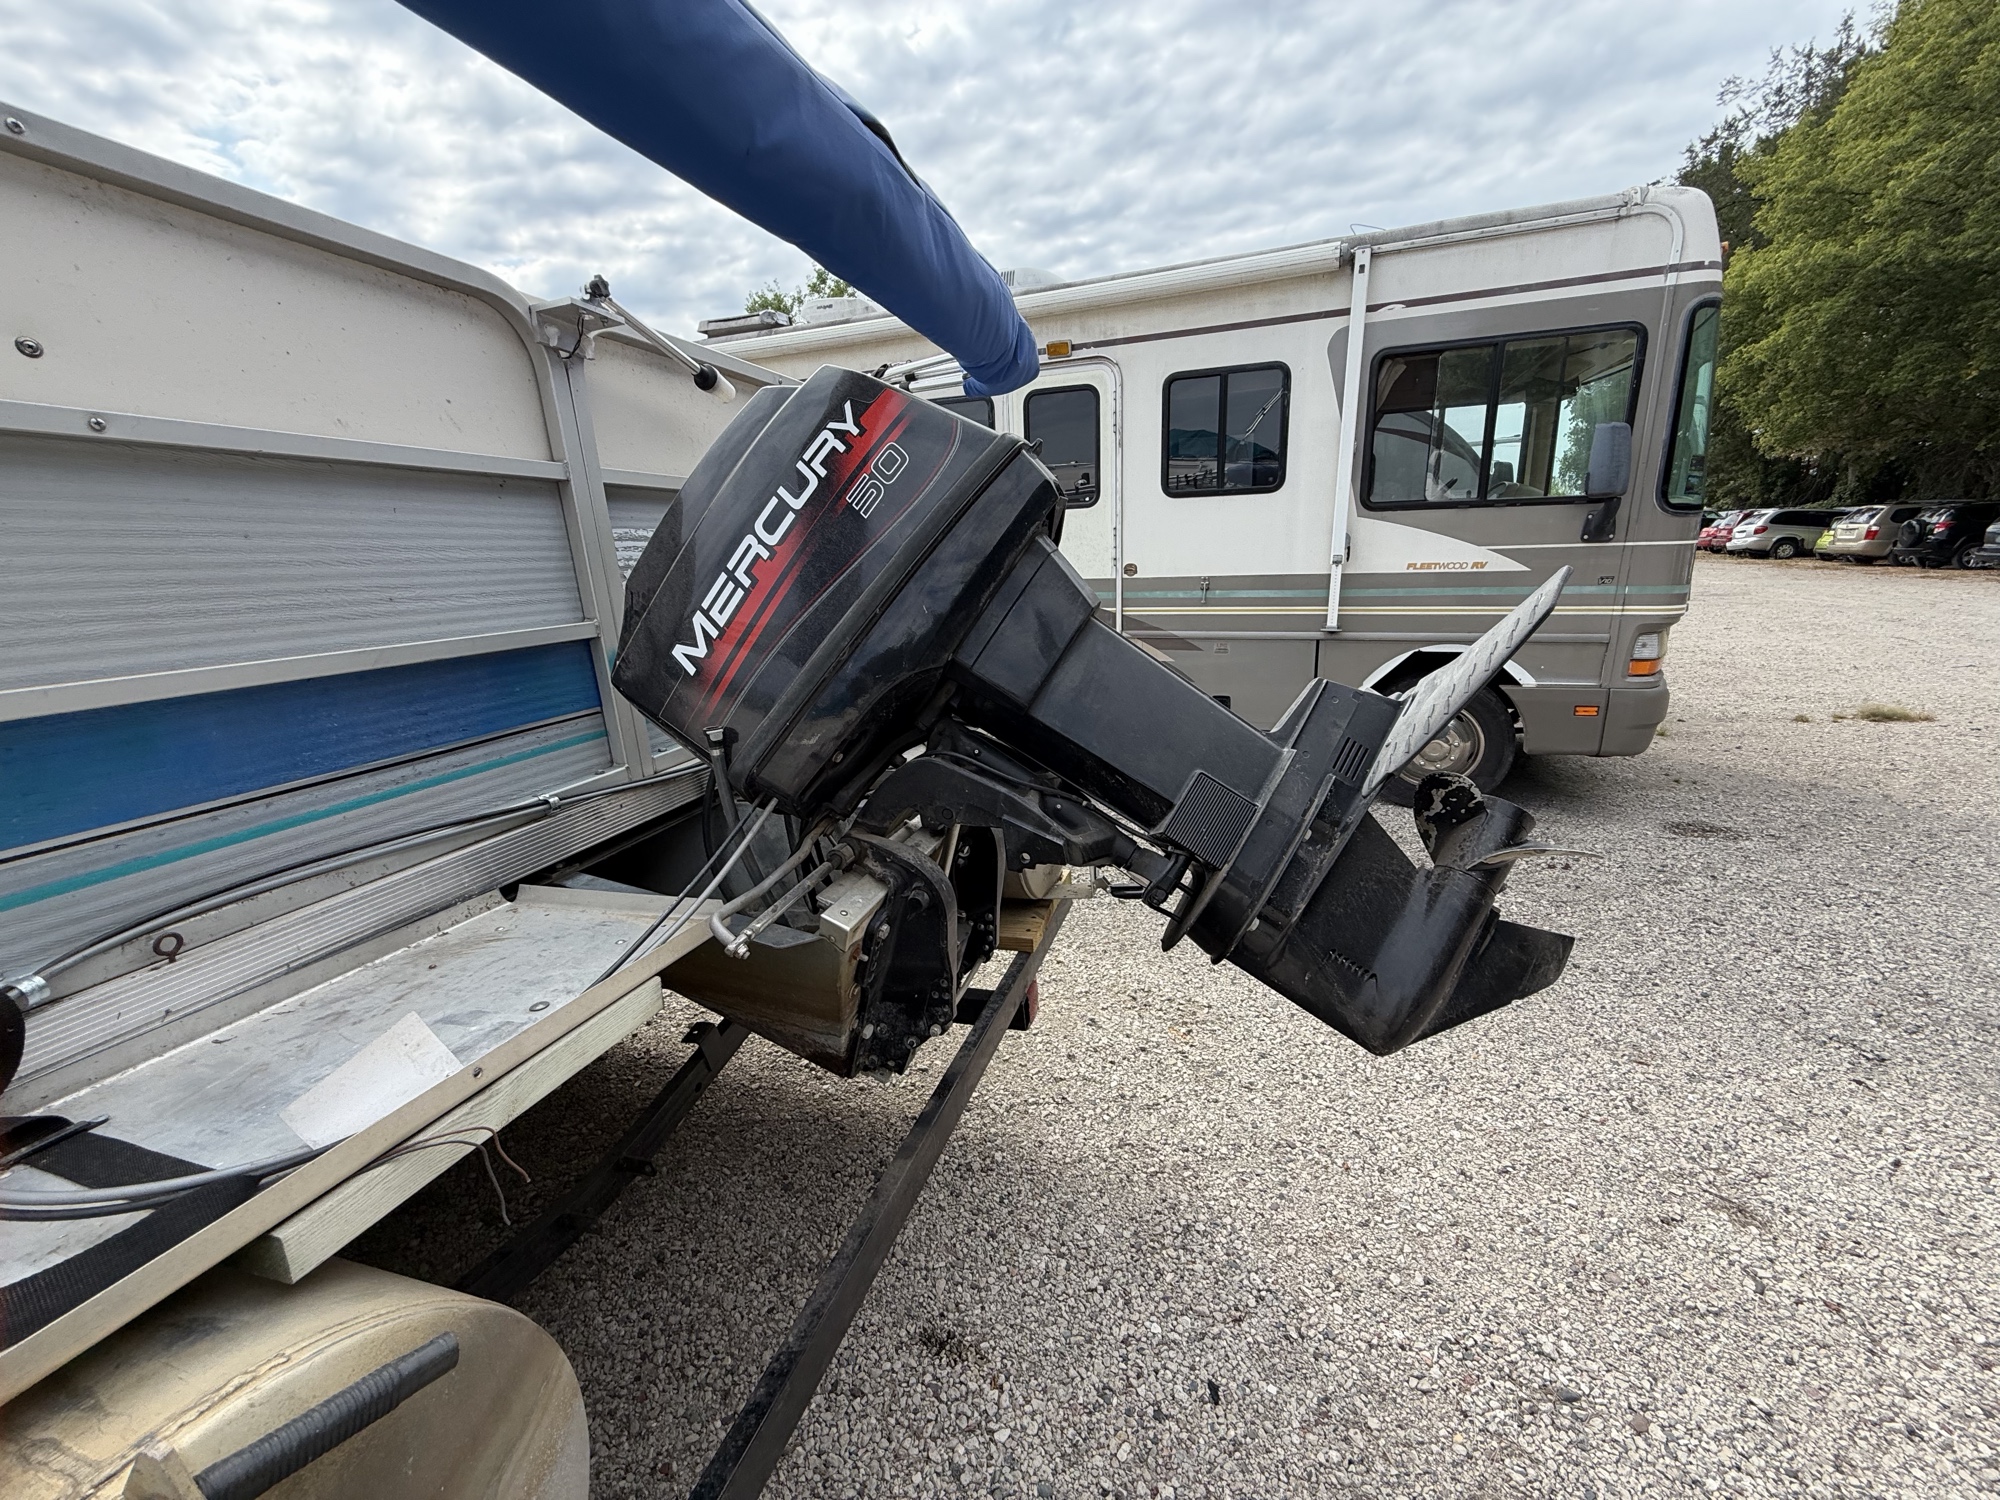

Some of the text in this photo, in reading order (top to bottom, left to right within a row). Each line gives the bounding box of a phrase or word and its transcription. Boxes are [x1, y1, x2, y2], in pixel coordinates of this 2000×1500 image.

[846, 442, 909, 518] 50
[671, 400, 859, 677] MERCURY
[1406, 561, 1488, 570] FLEETWOOD RV
